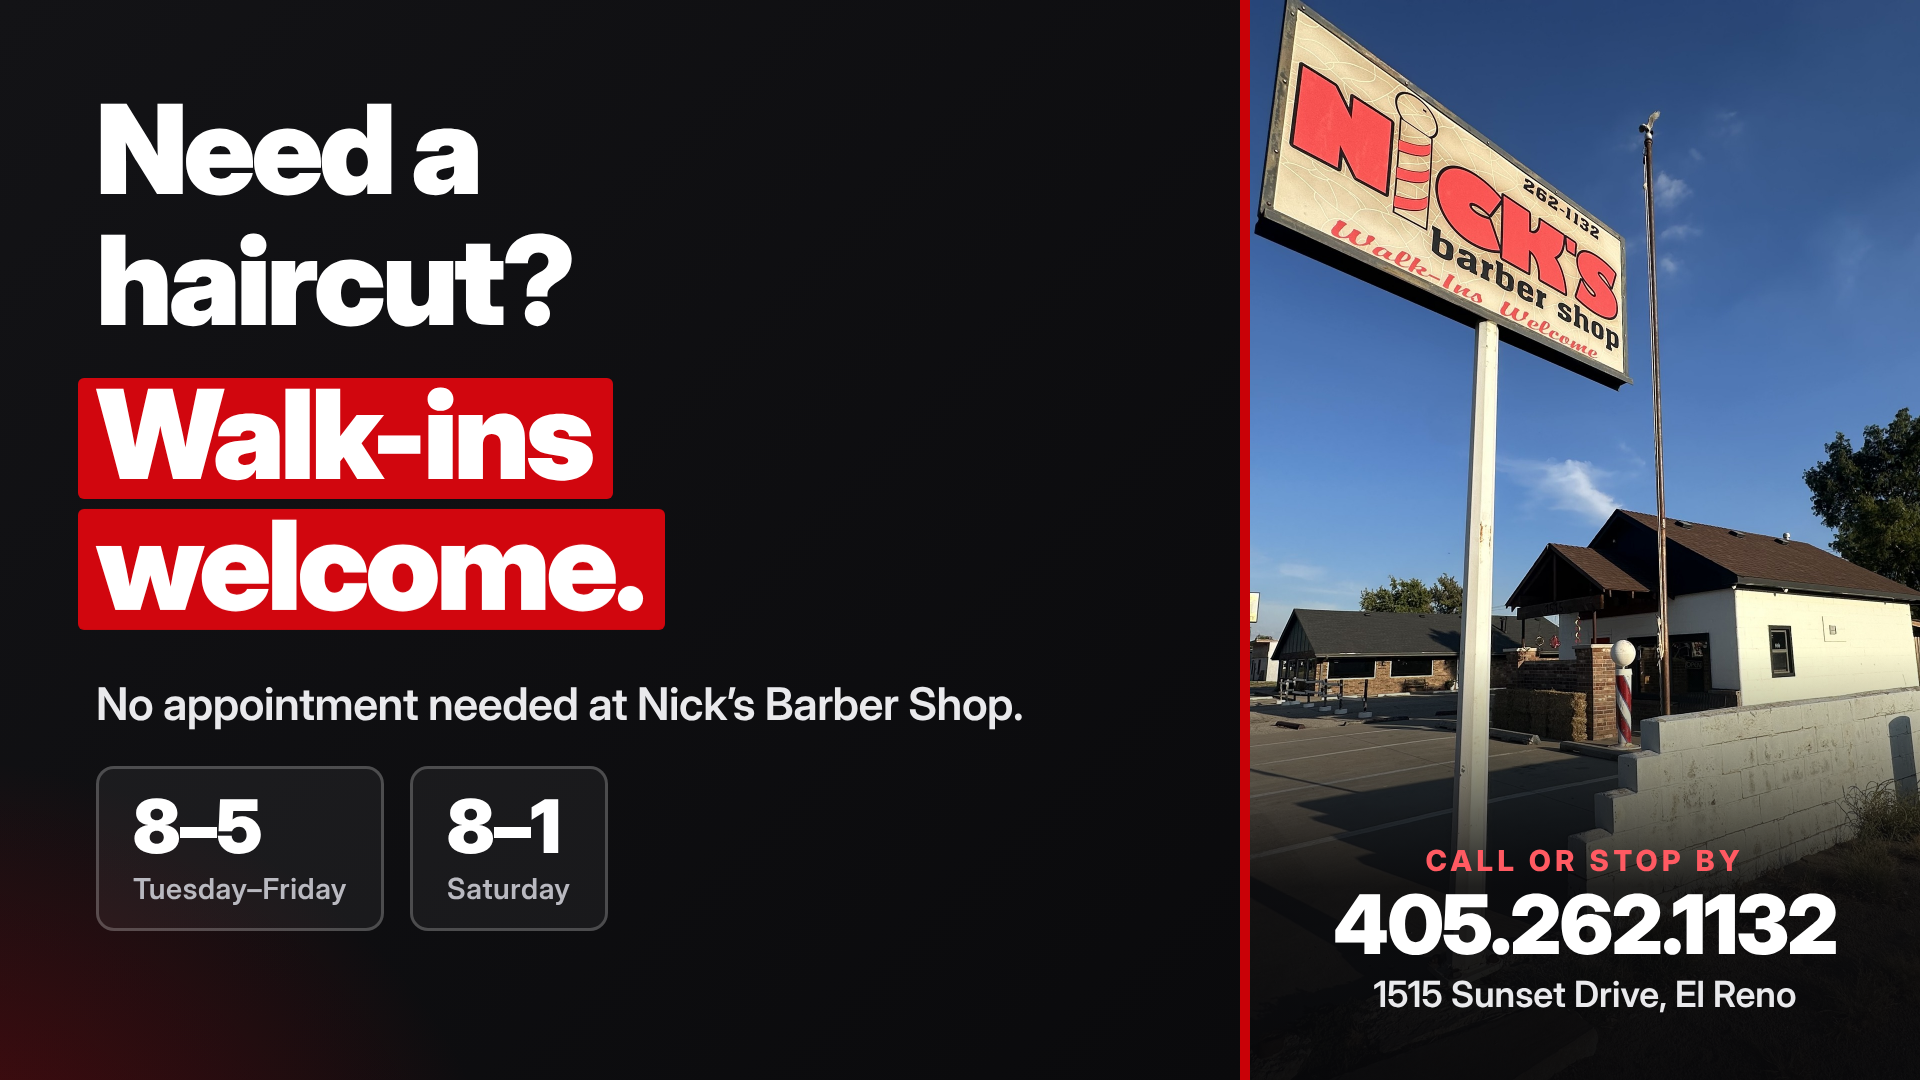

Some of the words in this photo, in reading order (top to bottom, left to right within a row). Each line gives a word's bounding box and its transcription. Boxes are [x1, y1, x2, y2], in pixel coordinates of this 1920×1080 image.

[1523, 178, 1600, 240] 262-1132
[1330, 219, 1483, 304] Walk-Ins
[1500, 301, 1598, 359] Welcome
[1431, 226, 1547, 309] barber
[1557, 300, 1620, 351] shop
[1545, 602, 1564, 614] 1515
